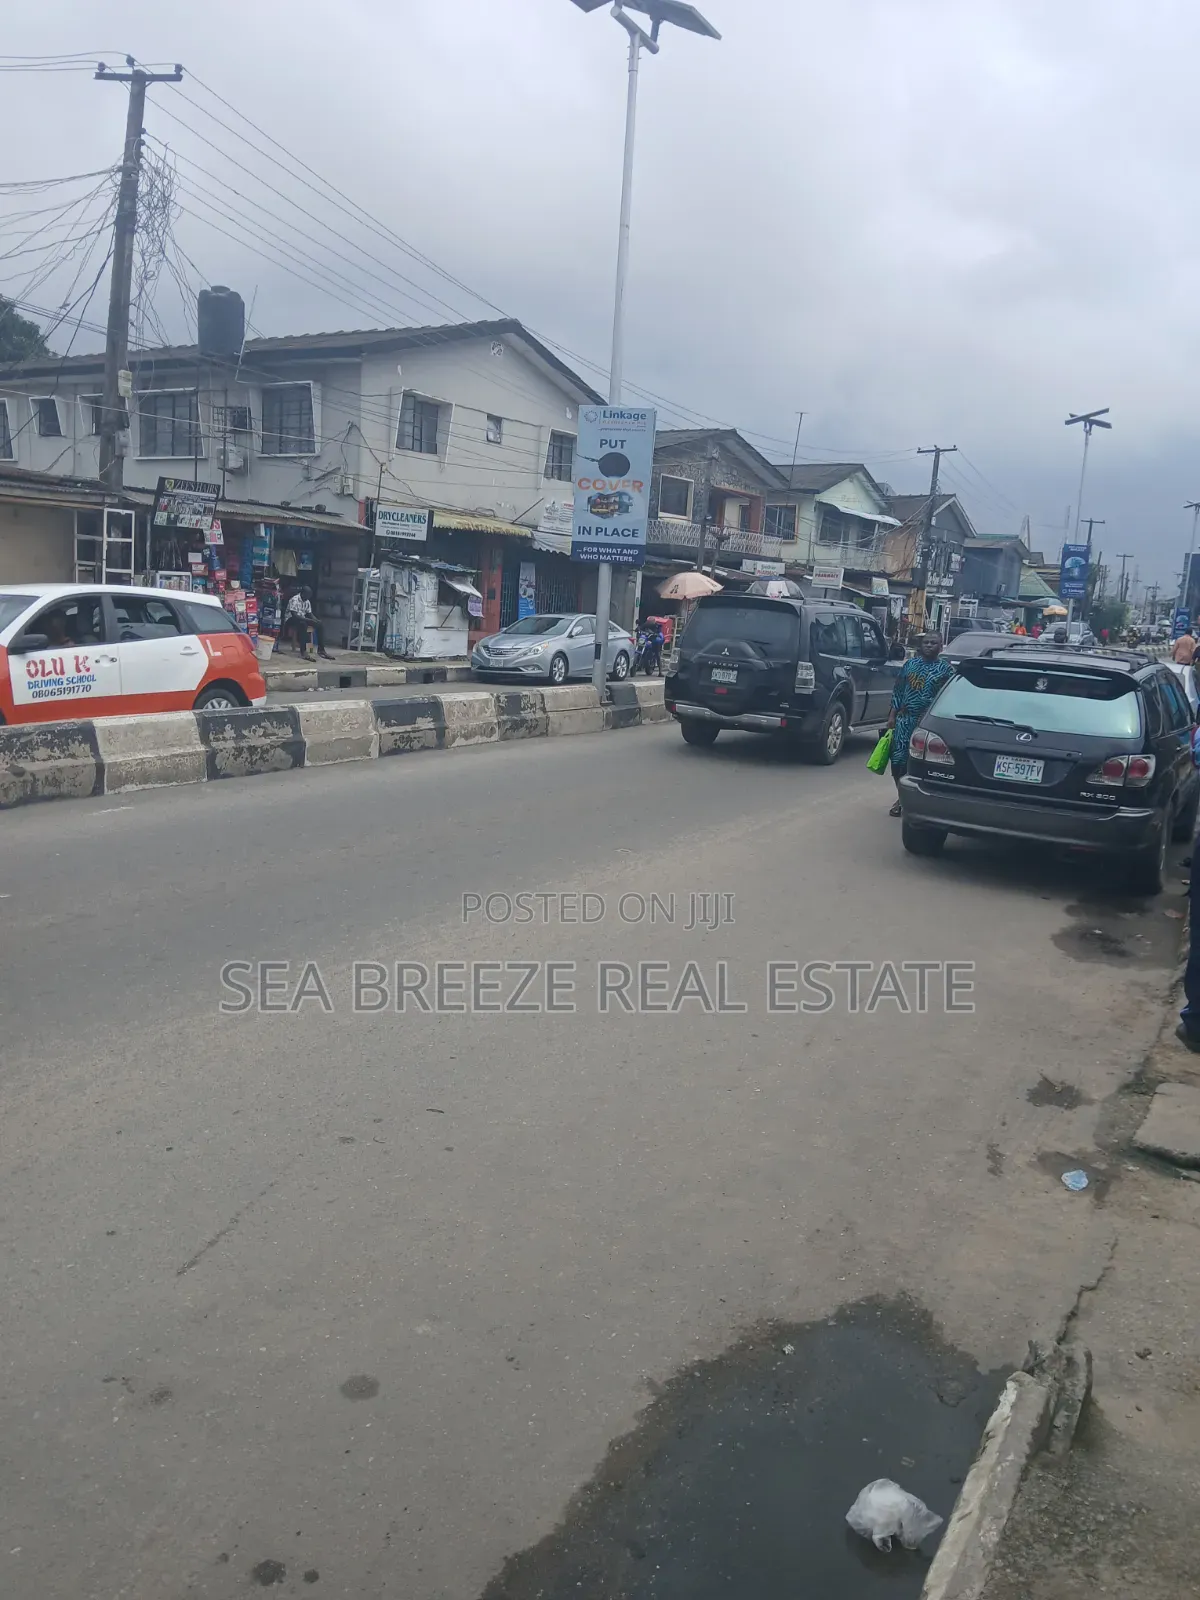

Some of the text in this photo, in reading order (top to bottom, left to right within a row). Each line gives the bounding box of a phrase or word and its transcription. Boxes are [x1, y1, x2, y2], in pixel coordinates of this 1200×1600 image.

[602, 410, 647, 421] Linkage
[599, 438, 627, 449] PUT
[577, 477, 644, 493] COVER
[378, 510, 427, 525] DRYCLEANERS
[577, 525, 640, 538] IN PLACE
[600, 554, 635, 562] MATTERS.
[26, 655, 91, 679] OLU K
[27, 674, 97, 690] DRIVING SCHOOL
[32, 684, 92, 699] 08065191770
